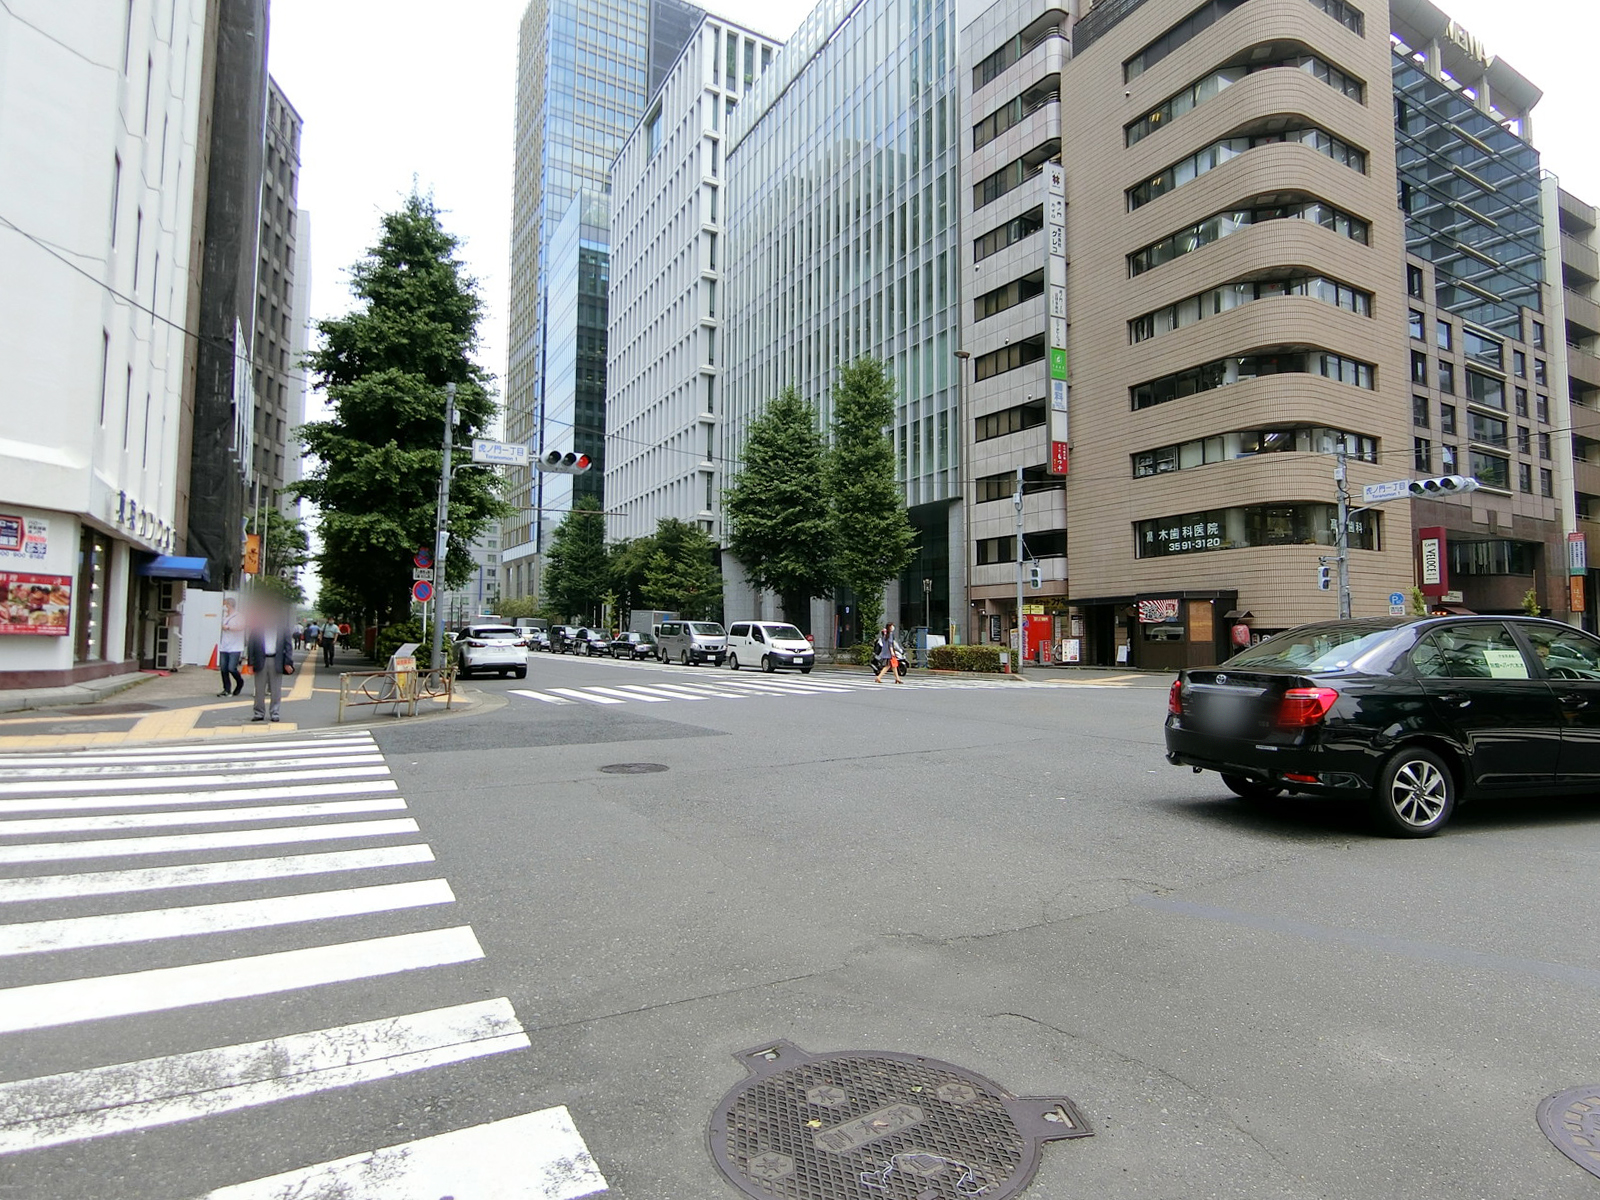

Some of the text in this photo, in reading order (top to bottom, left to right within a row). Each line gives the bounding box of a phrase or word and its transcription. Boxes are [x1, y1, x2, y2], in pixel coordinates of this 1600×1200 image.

[478, 444, 524, 457] 虎ノ門一丁目
[1366, 482, 1406, 495] 虎ノ門一丁目
[1168, 538, 1220, 551] 3591-3120
[1426, 549, 1437, 572] VELOCE
